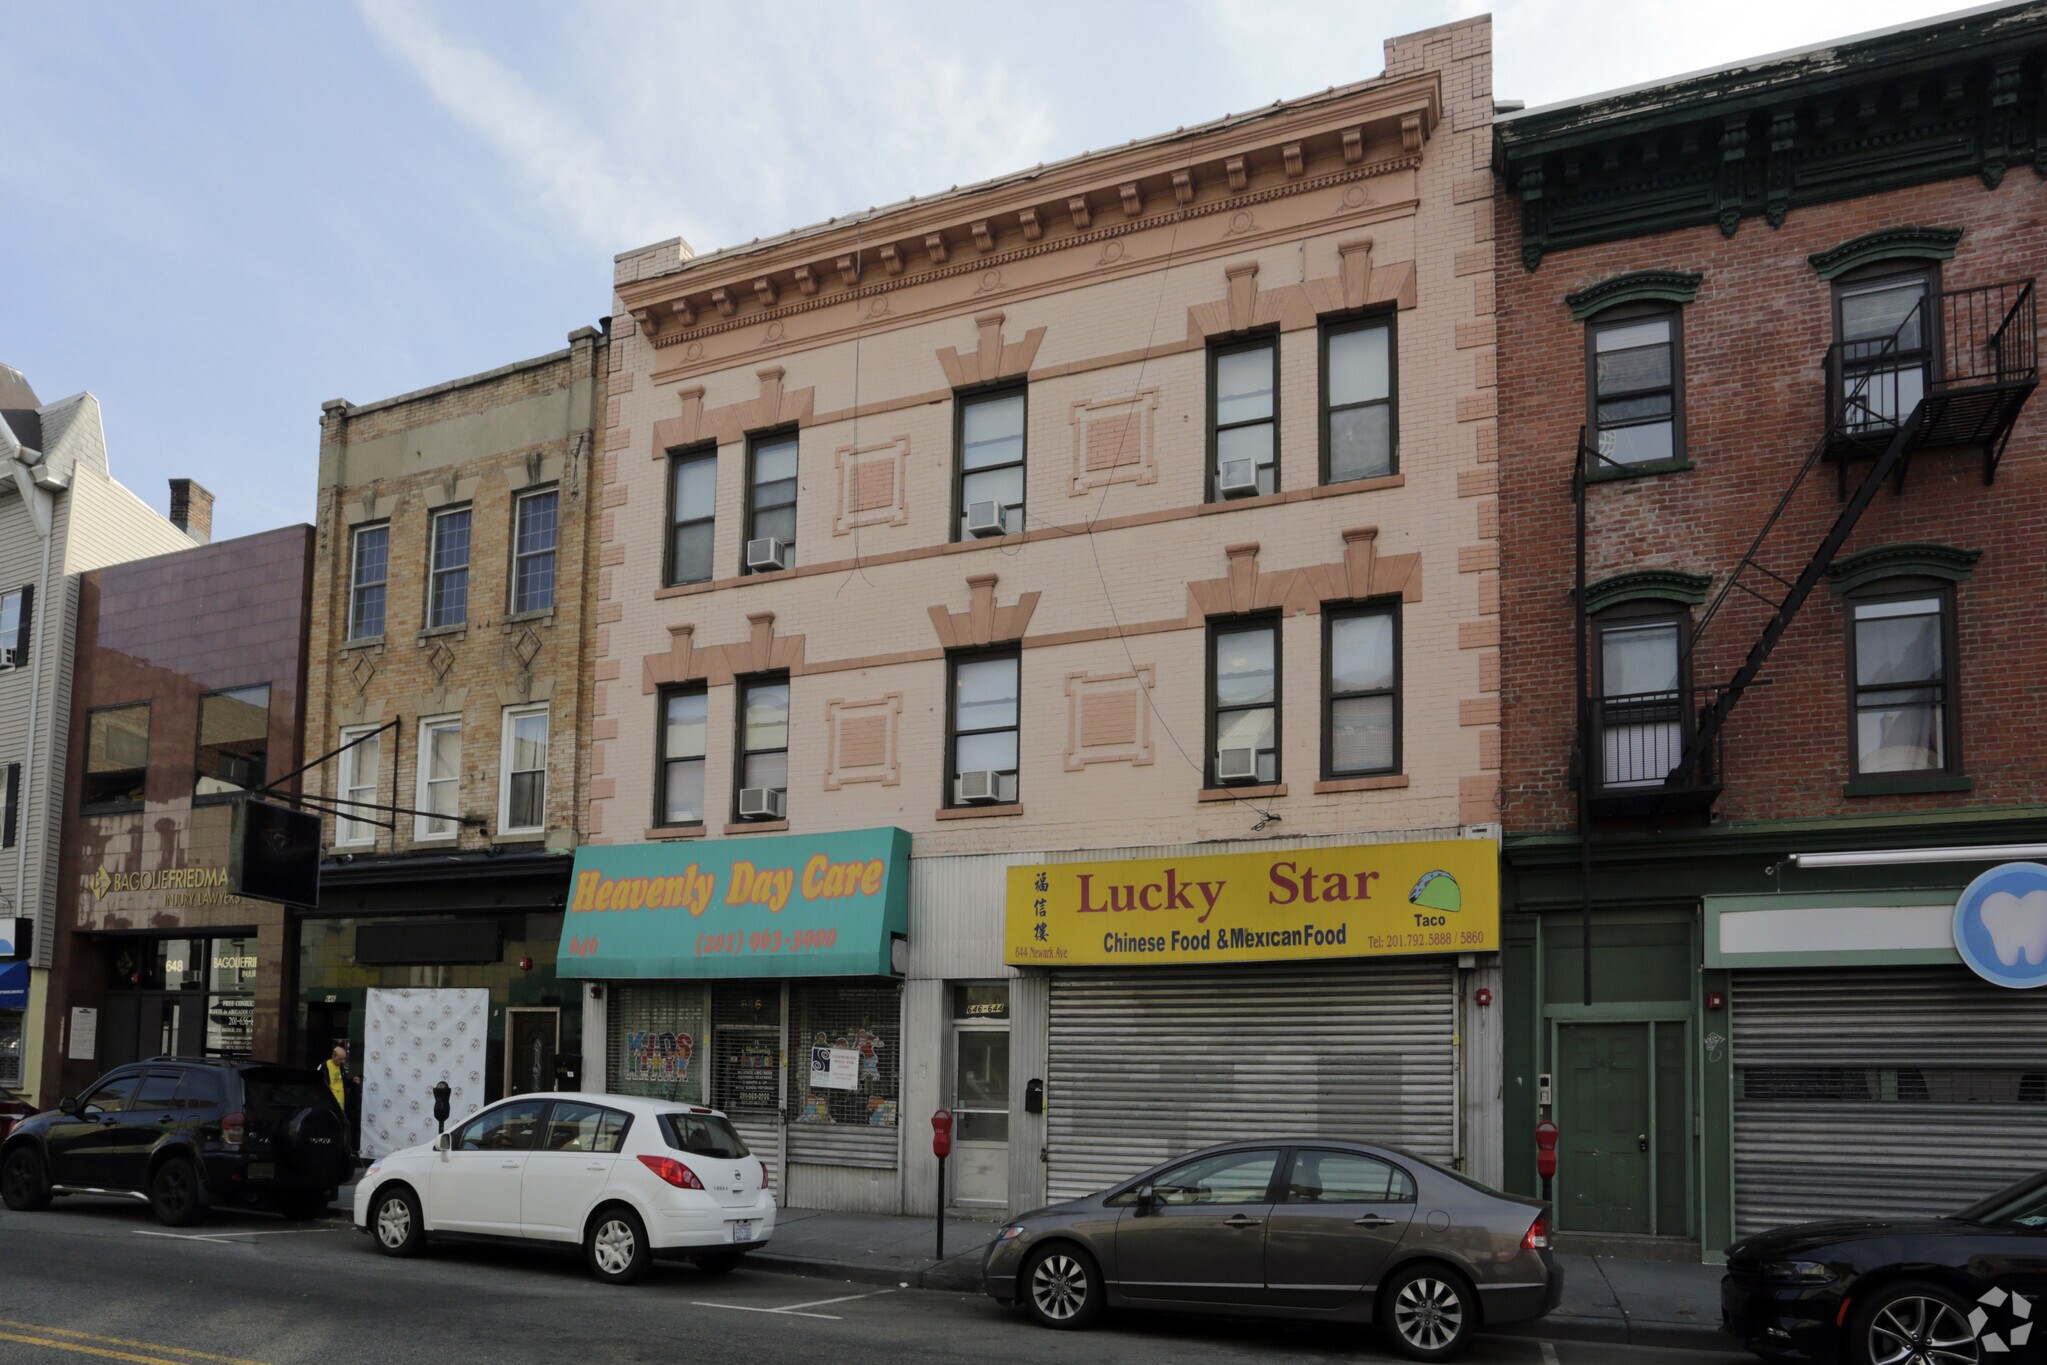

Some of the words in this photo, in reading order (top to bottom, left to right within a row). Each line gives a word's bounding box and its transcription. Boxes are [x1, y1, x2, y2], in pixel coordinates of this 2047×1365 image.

[571, 862, 716, 918] Heavenly
[724, 861, 795, 913] Day
[801, 853, 885, 901] Care
[1076, 867, 1227, 923] Lucky
[1268, 861, 1380, 905] Star
[165, 893, 195, 906] INJURY
[1414, 914, 1446, 927] Taco
[569, 934, 599, 957] 646
[695, 929, 744, 958] (201)
[1104, 932, 1166, 953] Chinese
[1171, 929, 1210, 951] Food
[1368, 935, 1384, 948] Tel:
[1387, 932, 1452, 948] 201.792.5888
[1460, 930, 1484, 944] 5860
[1015, 947, 1028, 958] 644
[1029, 947, 1054, 959] Newark
[1055, 947, 1068, 959] Ave
[165, 960, 184, 973] 648
[967, 1004, 1003, 1014] 646-644
[626, 1030, 694, 1062] KIDS
